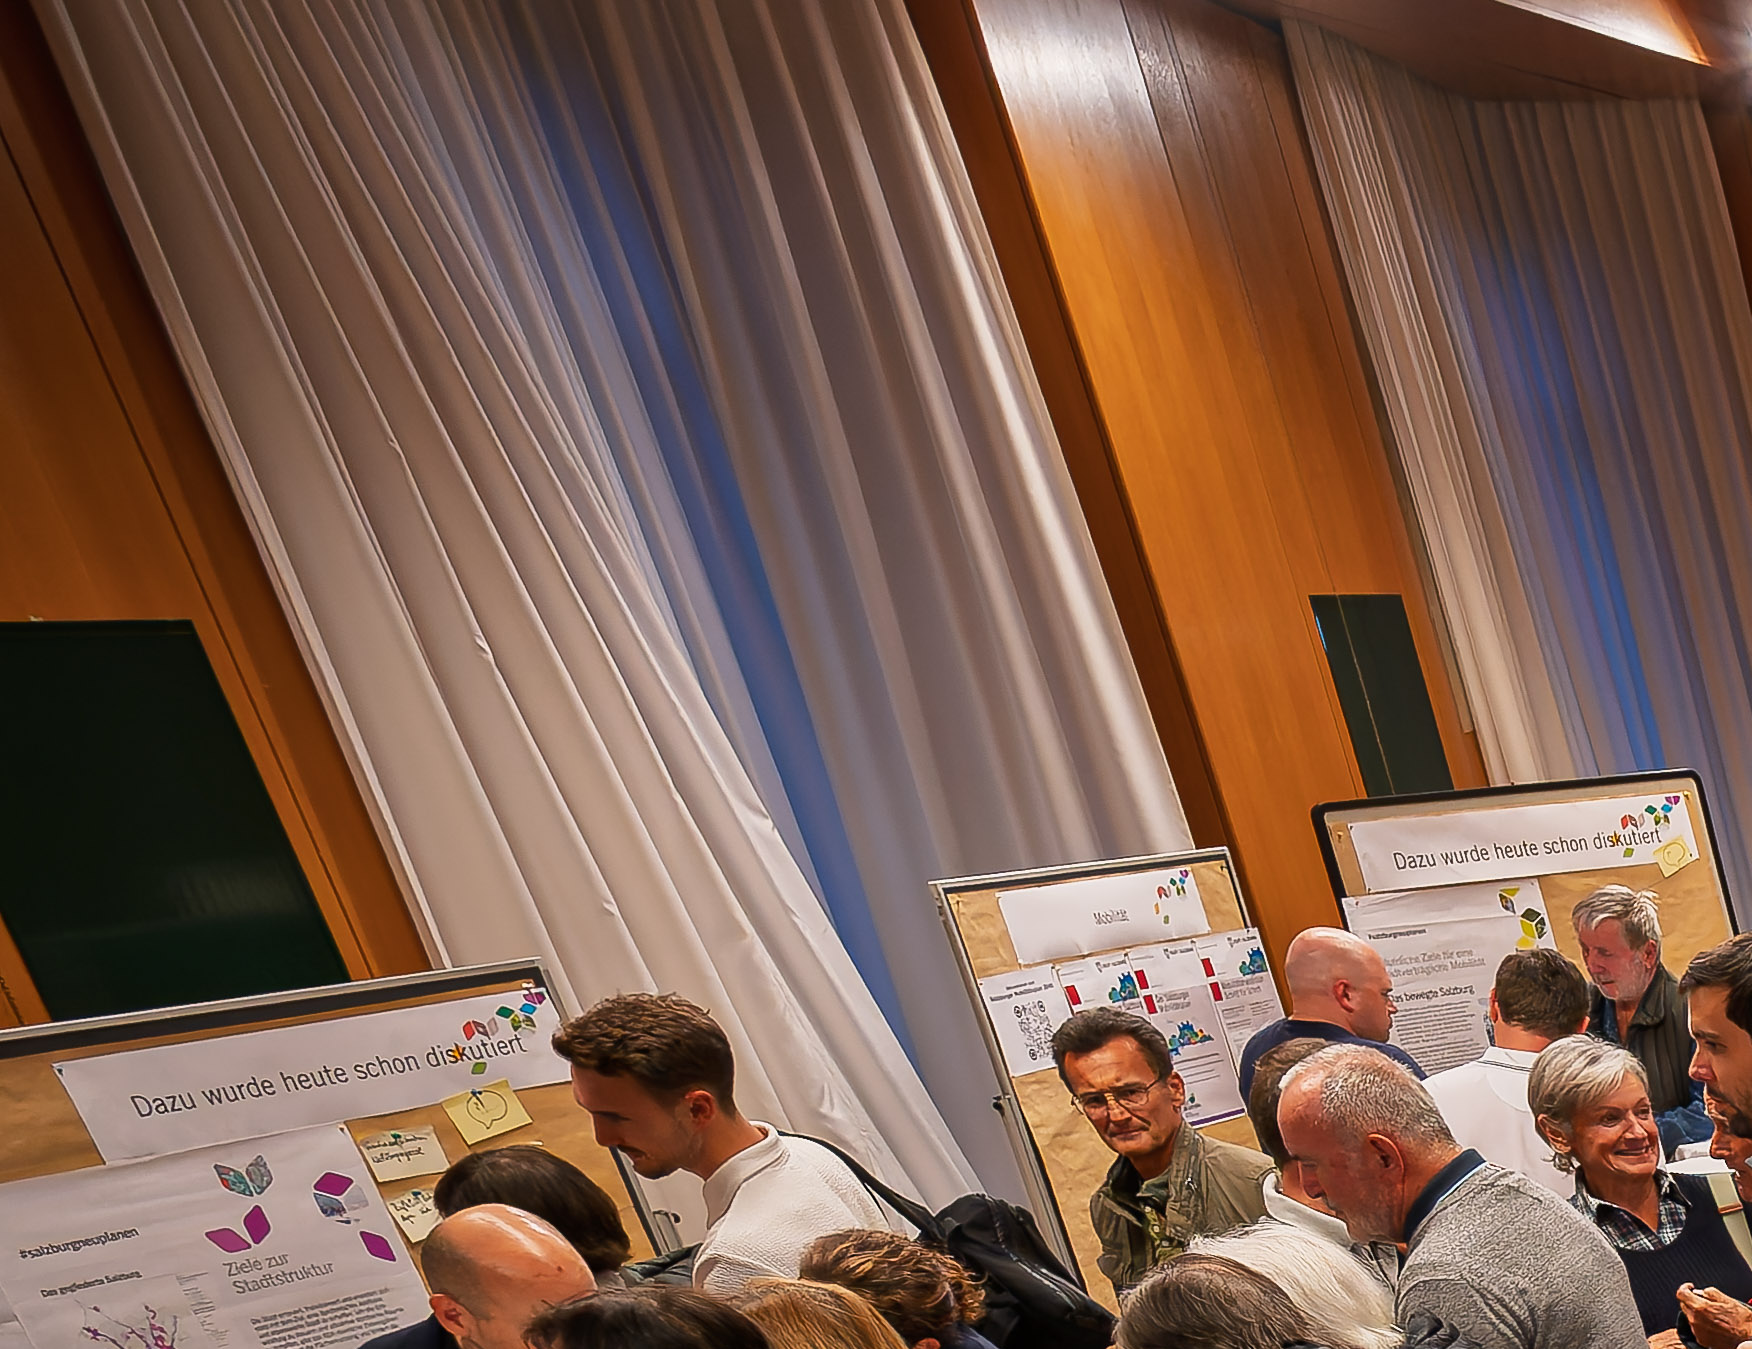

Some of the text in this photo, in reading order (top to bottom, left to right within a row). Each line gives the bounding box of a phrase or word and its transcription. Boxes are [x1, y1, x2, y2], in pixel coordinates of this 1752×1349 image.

[1393, 828, 1662, 871] Dazu wurde heute schon diskutiert
[130, 1034, 529, 1118] Dazu wurde heute schon diskutiert
[18, 1226, 140, 1260] #salzburgneuplanen
[223, 1252, 289, 1278] Ziele zur
[232, 1262, 335, 1295] Stadtstruktur
